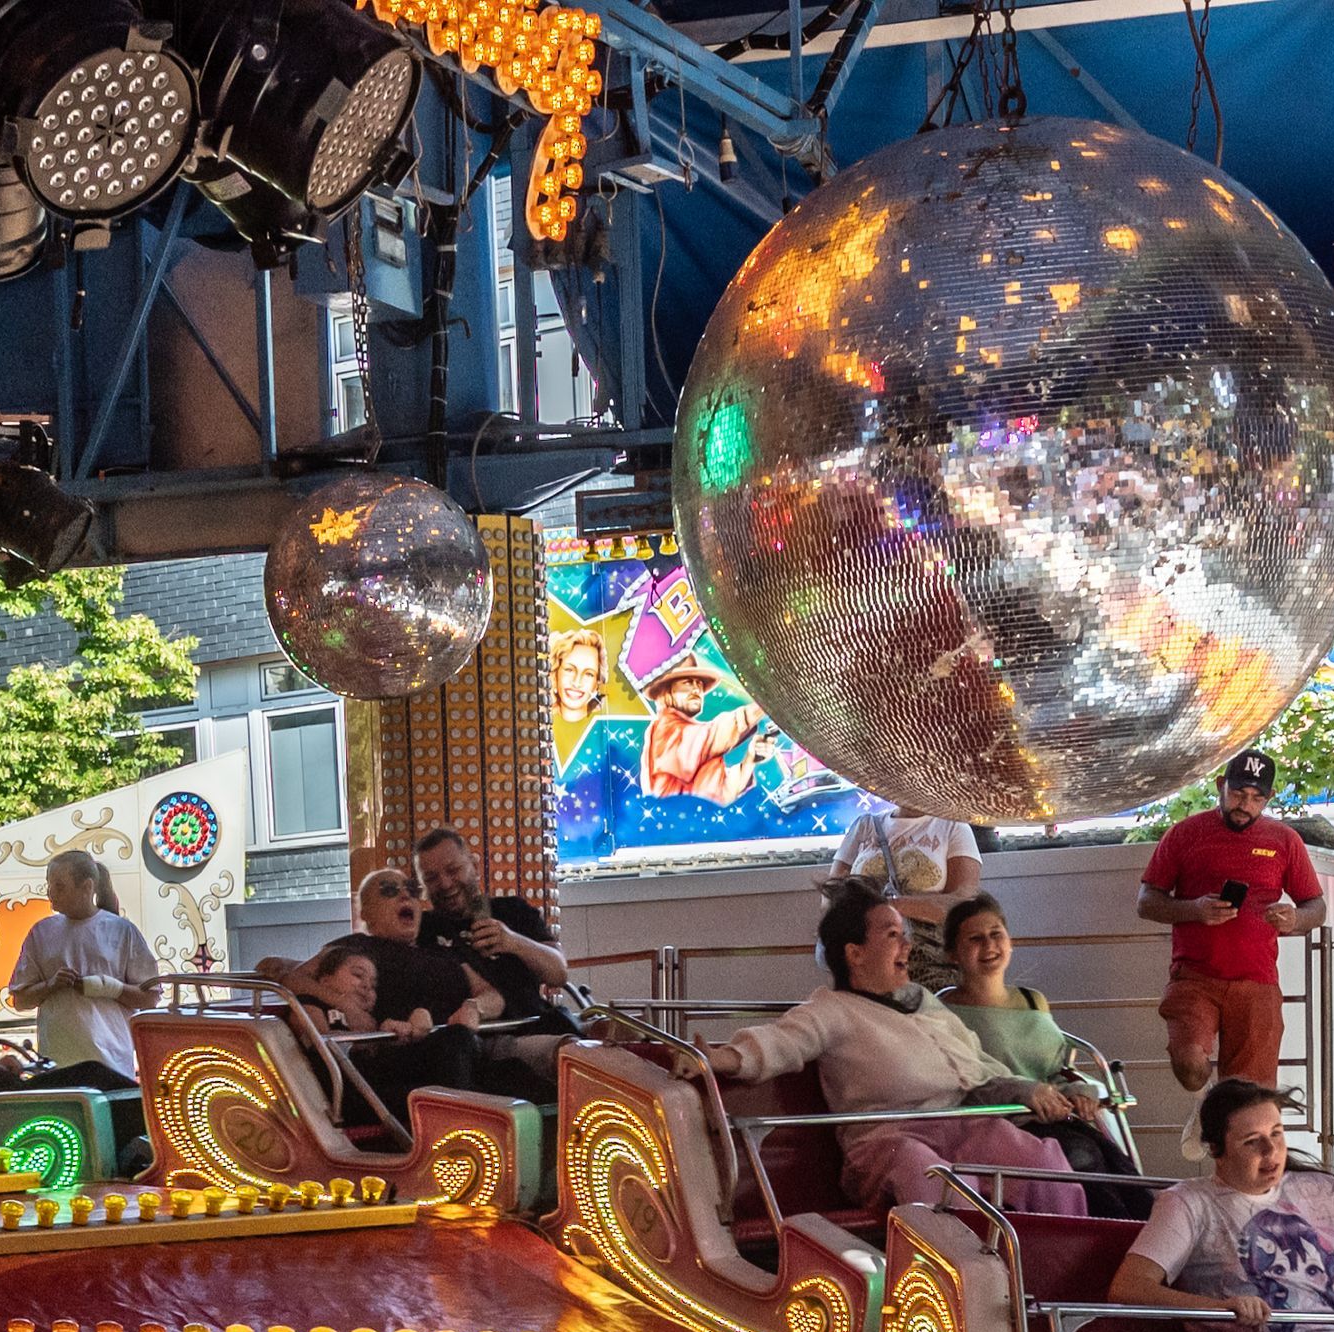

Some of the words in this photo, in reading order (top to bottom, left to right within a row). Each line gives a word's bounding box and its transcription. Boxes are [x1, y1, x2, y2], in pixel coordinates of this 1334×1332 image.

[1244, 757, 1266, 777] NY
[1252, 848, 1277, 858] CREW
[235, 1121, 275, 1154] 20
[630, 1197, 658, 1234] 19
